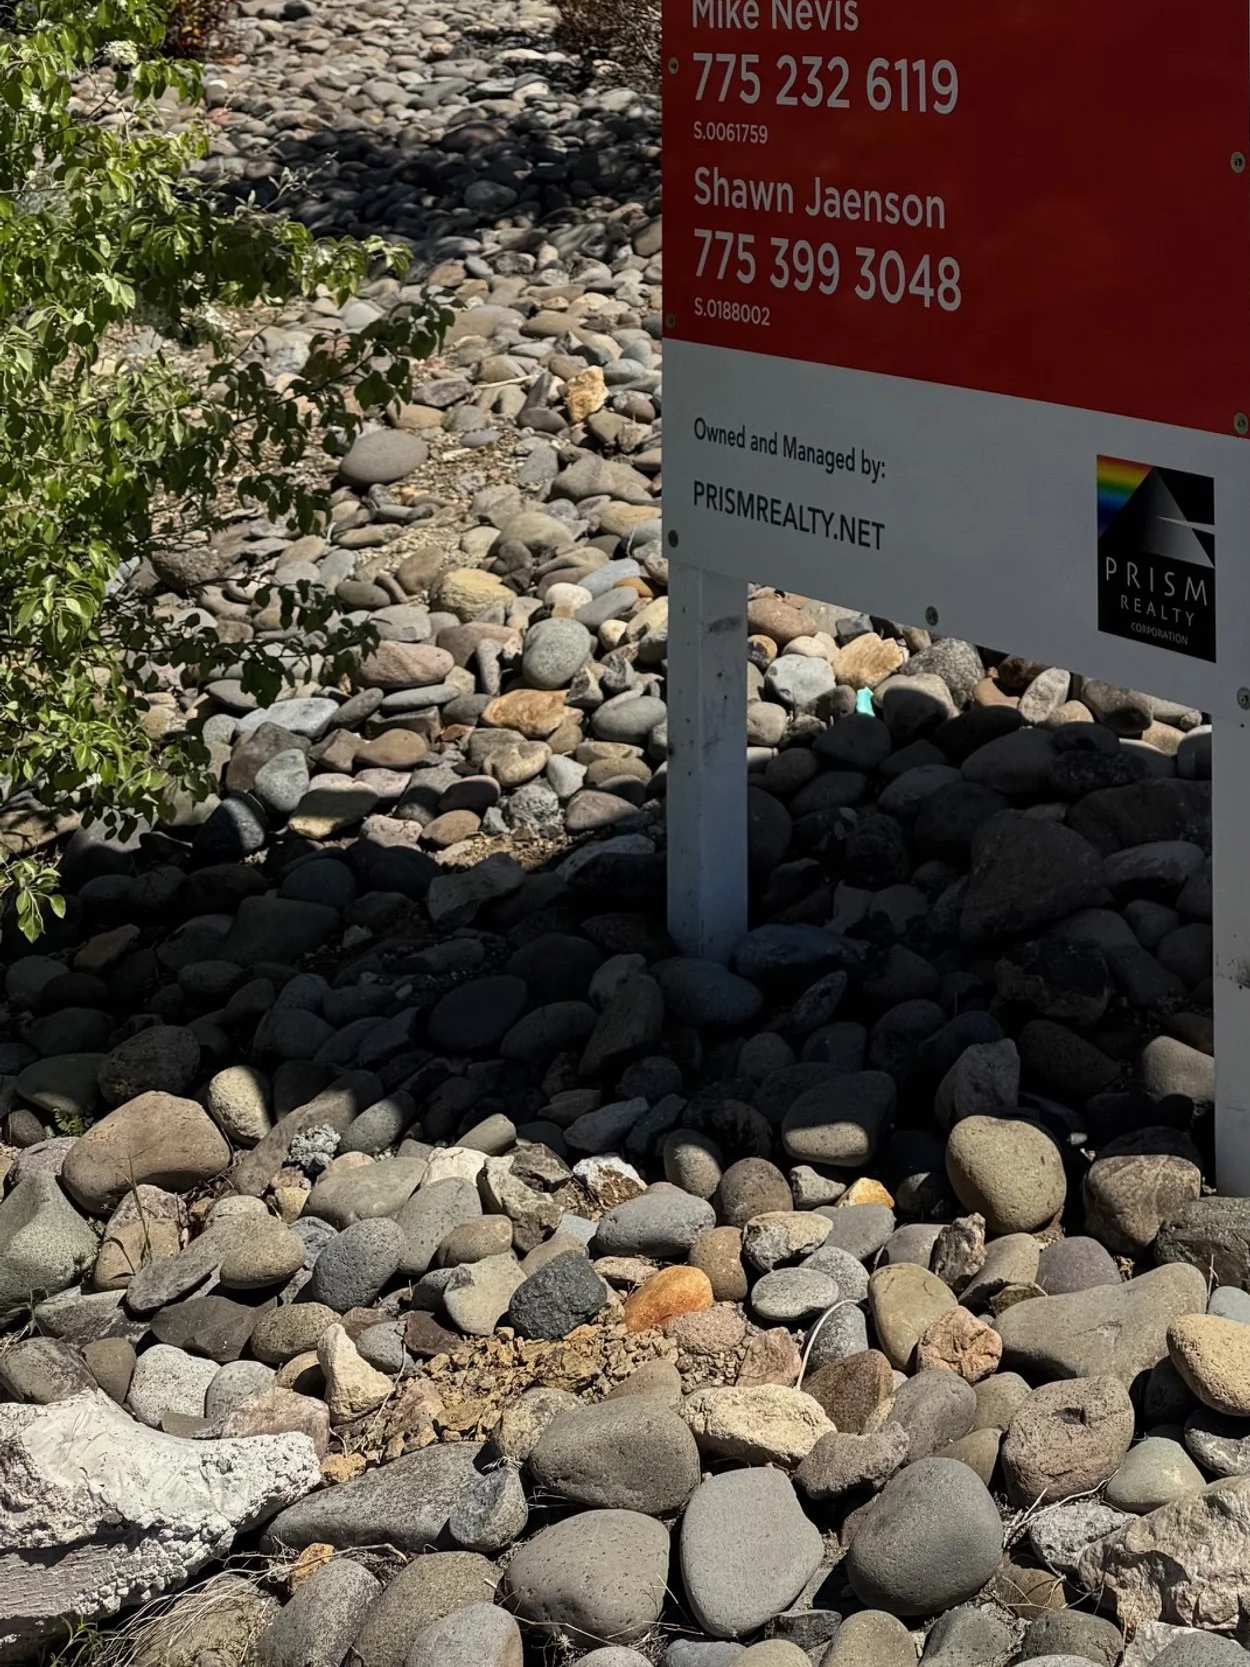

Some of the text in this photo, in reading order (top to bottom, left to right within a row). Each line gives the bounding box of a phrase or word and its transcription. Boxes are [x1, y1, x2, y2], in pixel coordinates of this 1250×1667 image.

[693, 52, 958, 114] 775 232 6119
[694, 121, 768, 144] S.0061759
[694, 167, 945, 229] Shawn Jaenson
[694, 229, 961, 312] 775 399 3048
[694, 298, 770, 326] S.0188002
[694, 417, 886, 483] Owned and Managed by:
[694, 480, 885, 551] PRISMREALTY.NET
[1106, 557, 1207, 606] PRISM
[1121, 595, 1194, 626] REALTY
[1131, 622, 1188, 645] CORPORATION
